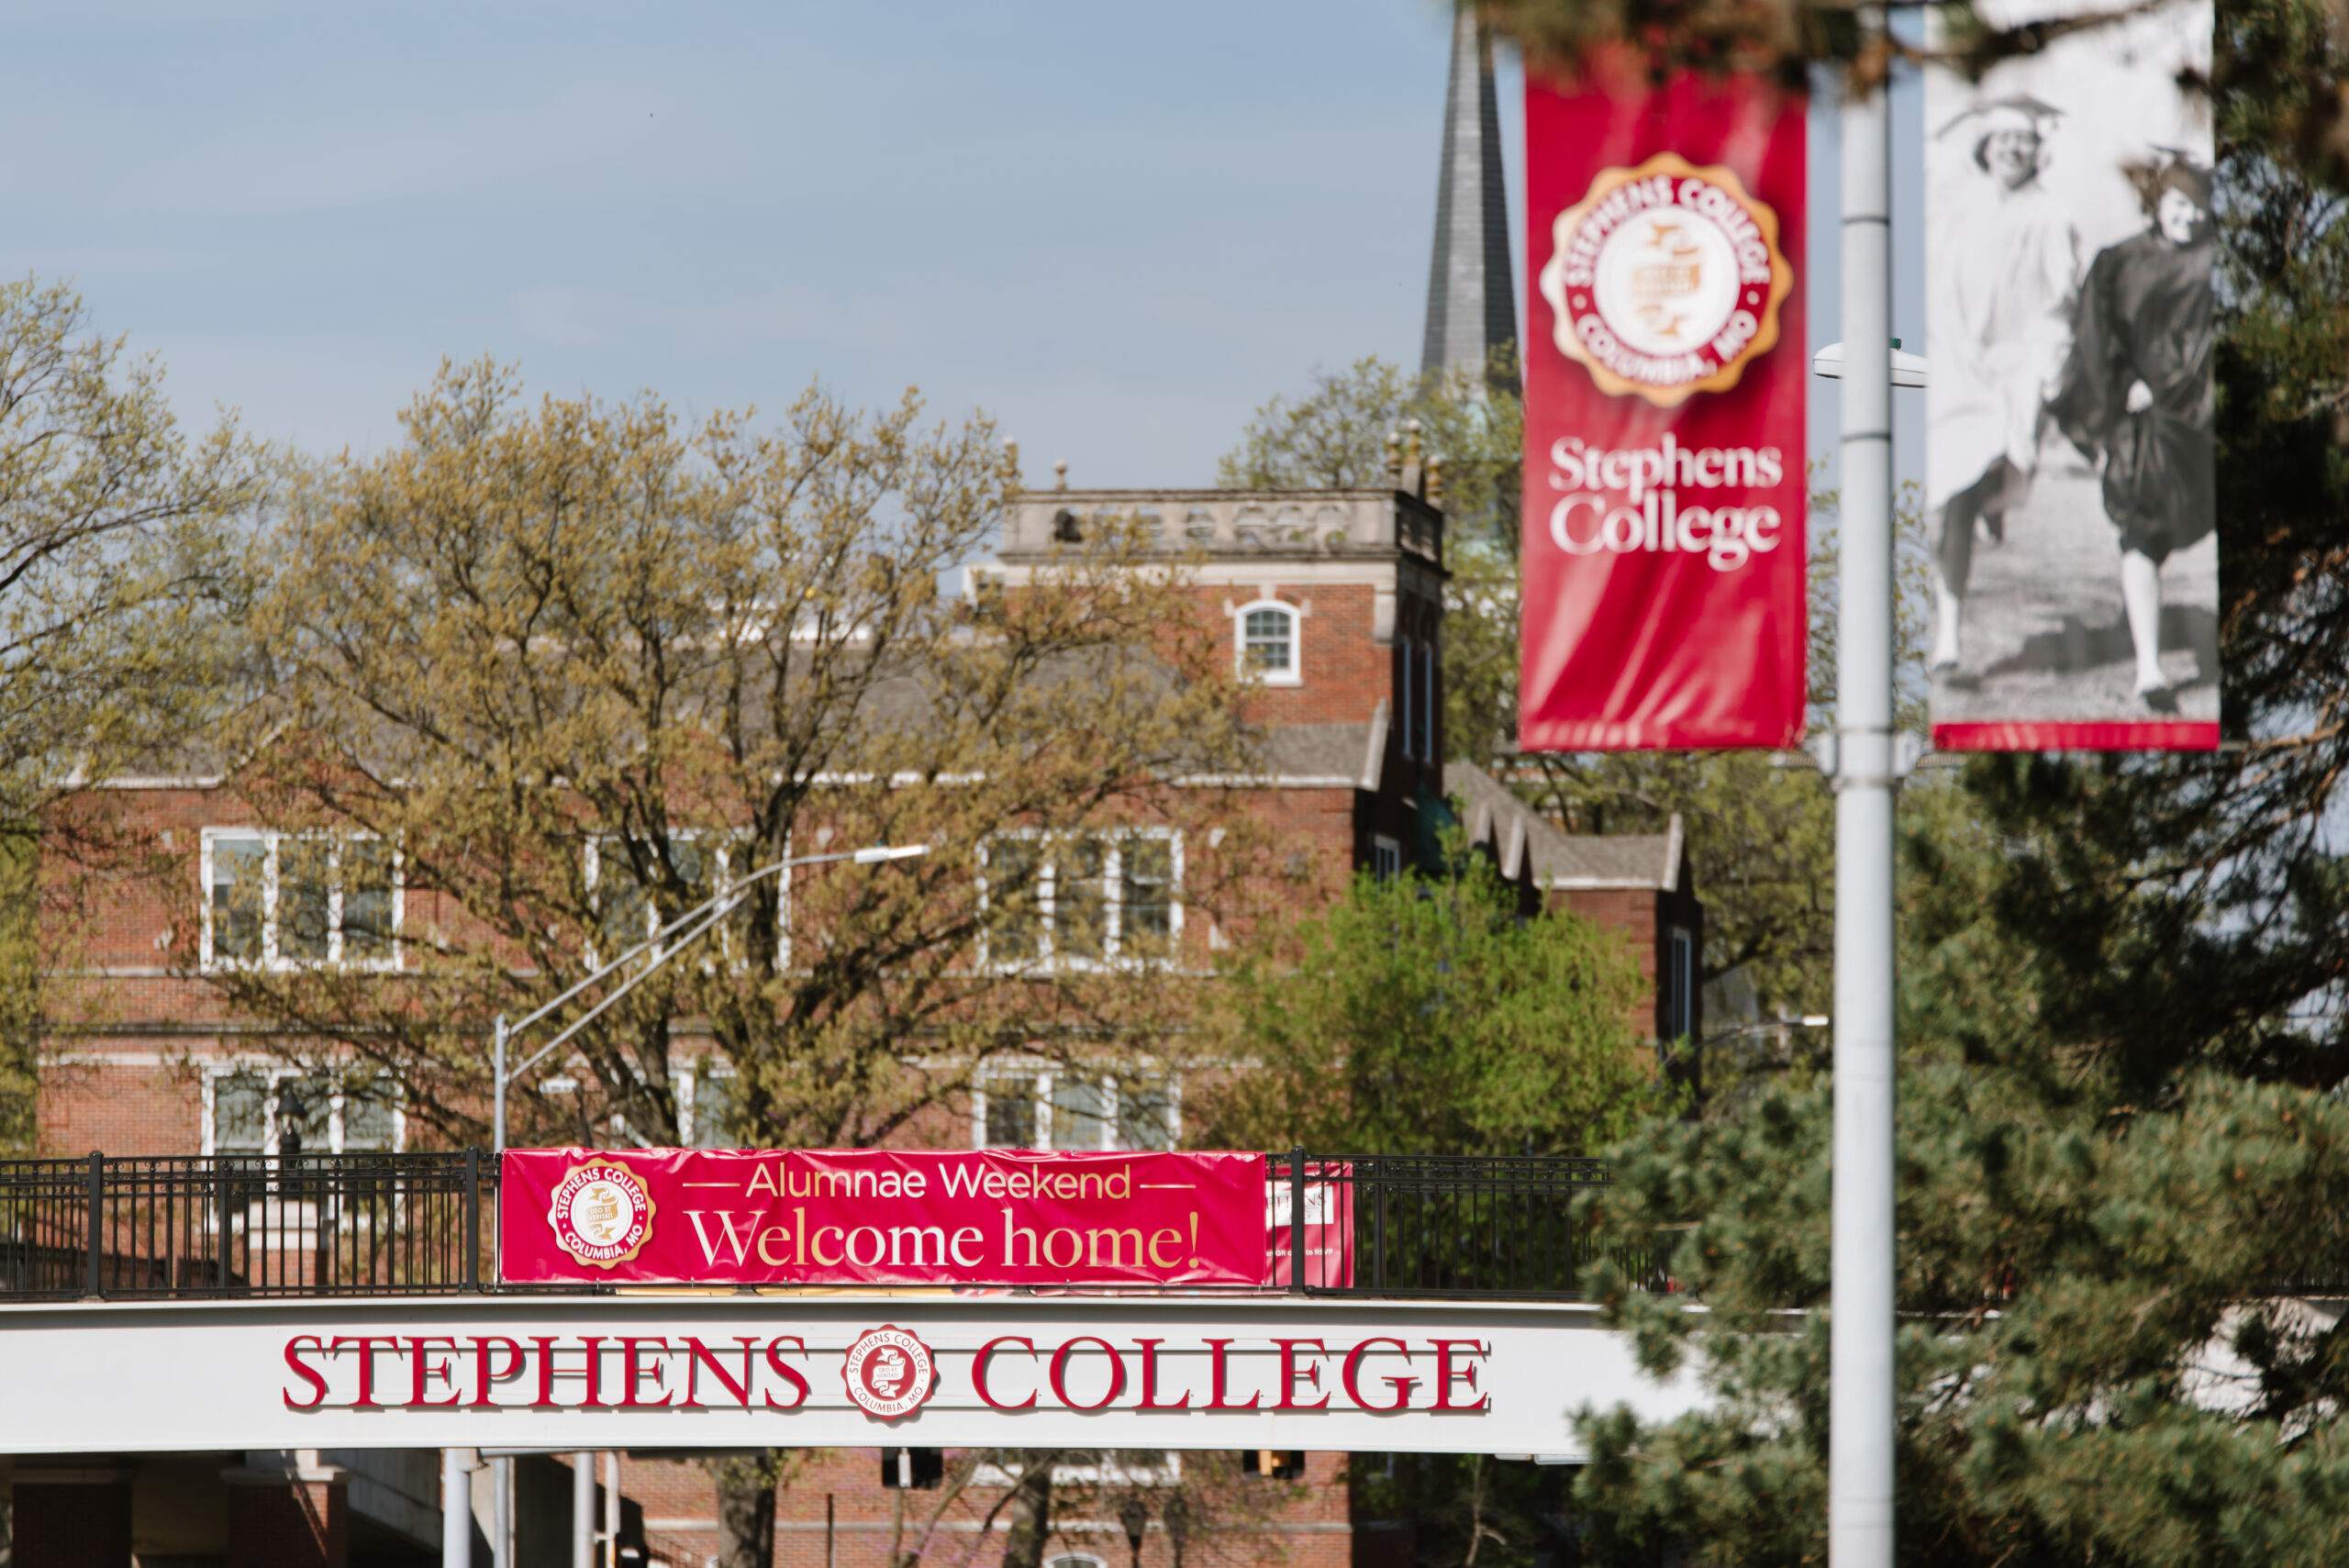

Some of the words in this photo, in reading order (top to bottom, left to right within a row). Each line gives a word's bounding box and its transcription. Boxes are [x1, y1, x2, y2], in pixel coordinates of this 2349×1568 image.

[1564, 173, 1674, 287] STEPHENS
[1677, 178, 1770, 284] COLLEGE
[1711, 309, 1758, 362] MO
[1549, 431, 1783, 505] Stephens
[1550, 489, 1781, 572] College
[556, 1168, 600, 1218] STEPHENS
[604, 1168, 646, 1212] COLLEGE
[745, 1162, 927, 1197] Alumnae
[939, 1163, 1130, 1198] Weekend
[626, 1225, 643, 1247] MO
[682, 1207, 985, 1266] Welcome
[1000, 1207, 1199, 1269] home!
[283, 1335, 808, 1409] STEPHENS
[971, 1336, 1488, 1410] COLLEGE
[849, 1333, 889, 1373] STEPHENS
[895, 1334, 928, 1373] COLLEGE
[907, 1386, 923, 1404] MO
